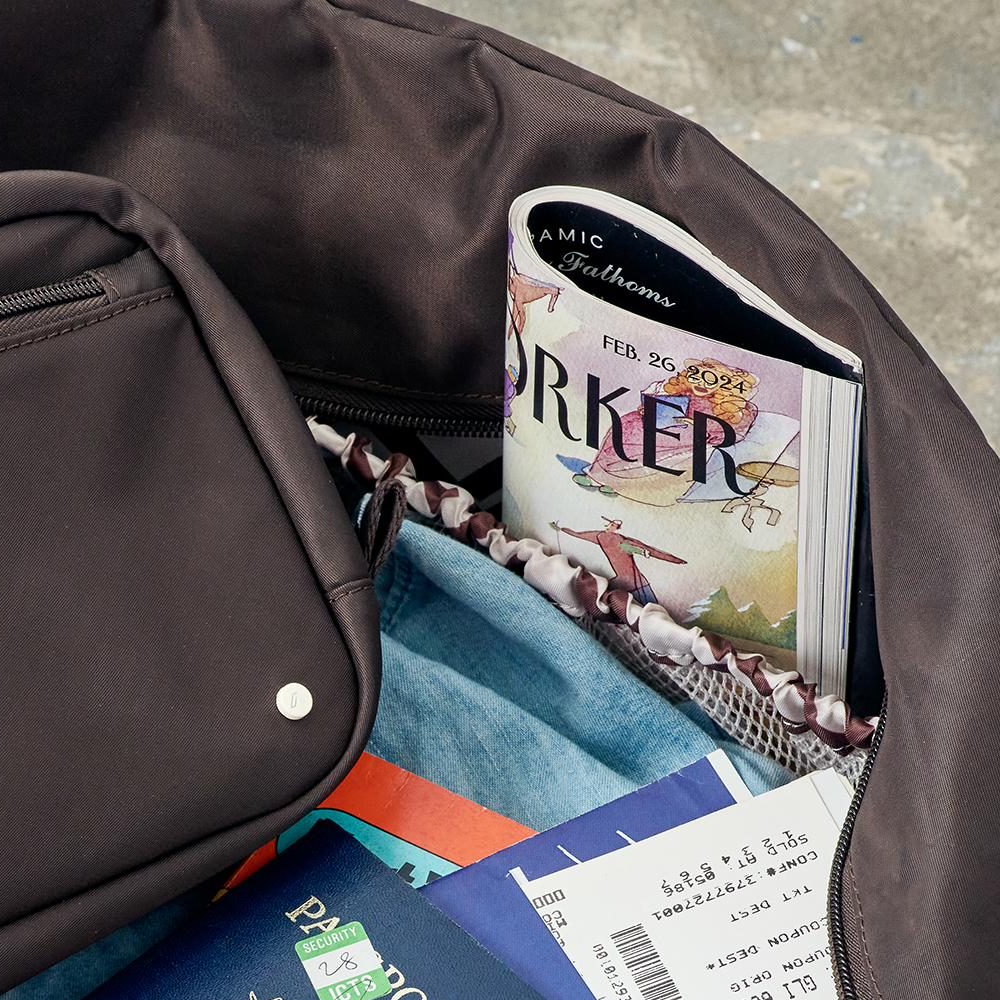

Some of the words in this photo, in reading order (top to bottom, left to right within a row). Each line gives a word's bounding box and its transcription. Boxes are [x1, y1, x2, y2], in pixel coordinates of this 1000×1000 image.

[558, 251, 677, 308] Fathoms
[602, 334, 641, 362] FEB.
[648, 352, 680, 376] 26,
[687, 365, 748, 394] 2024
[767, 833, 809, 856] SOLD
[663, 871, 716, 898] 05186
[782, 885, 813, 903] TKT
[730, 900, 772, 923] DEST
[302, 926, 358, 954] SECURITY
[730, 970, 772, 993] ORIG
[782, 974, 817, 999] GLI
